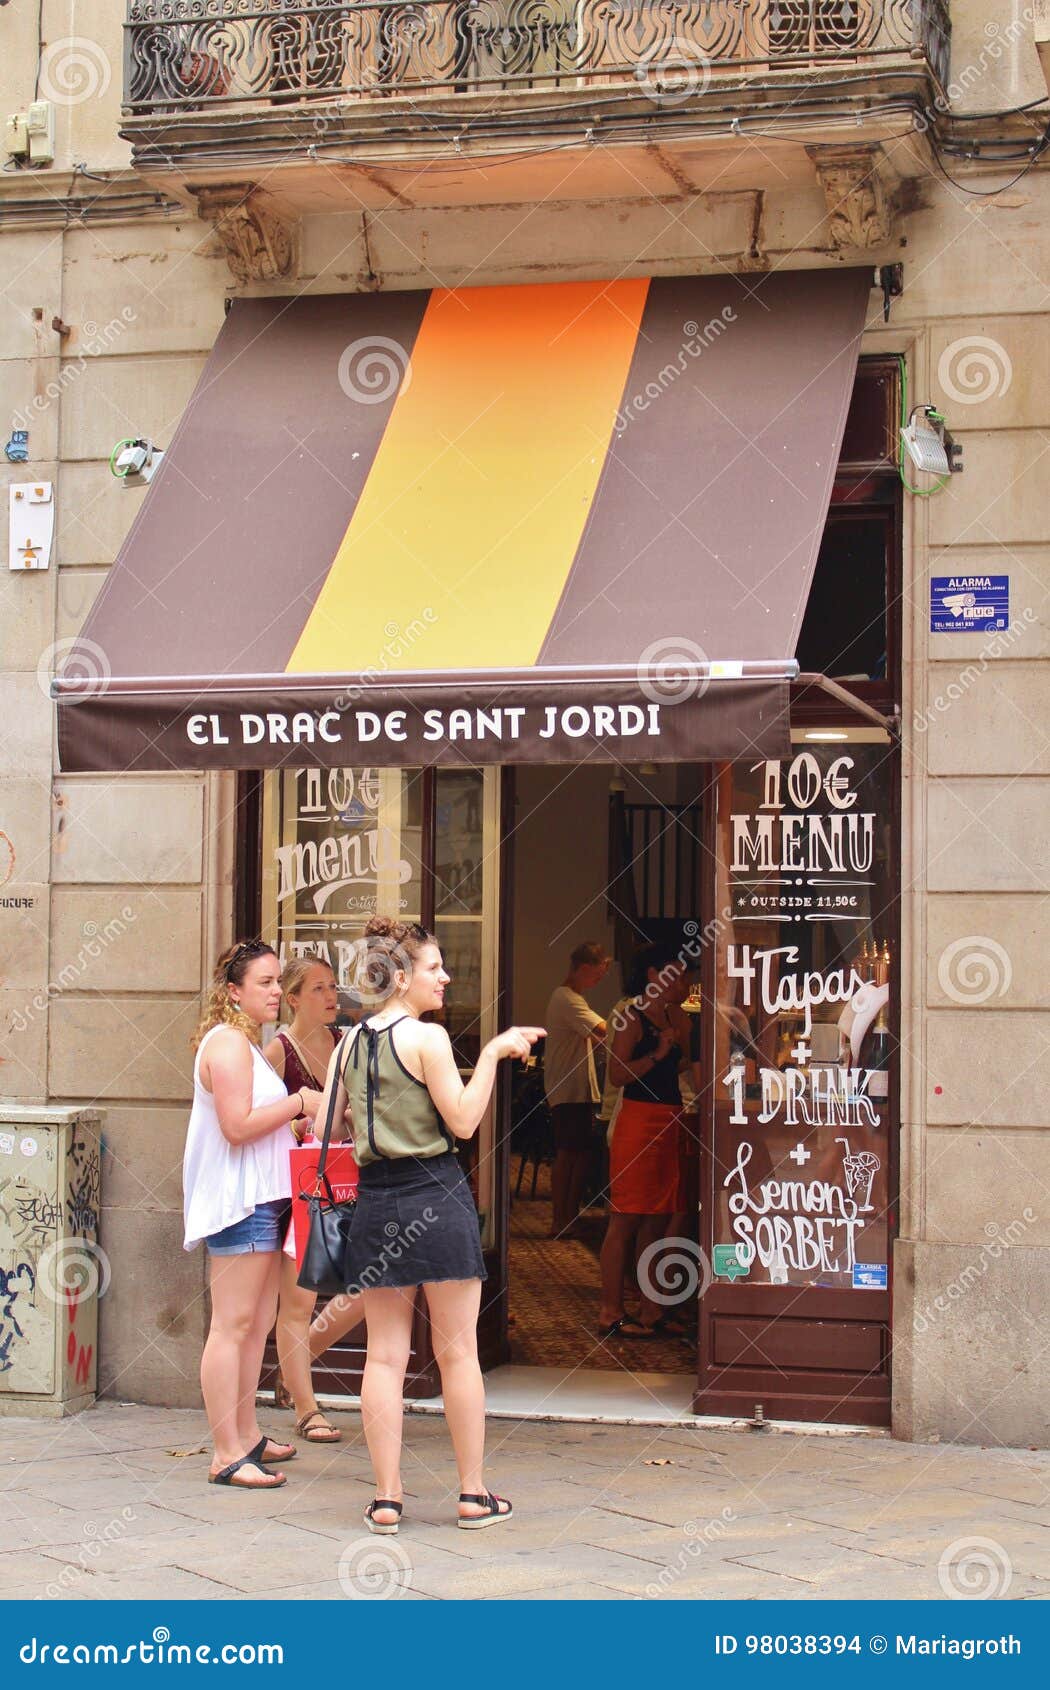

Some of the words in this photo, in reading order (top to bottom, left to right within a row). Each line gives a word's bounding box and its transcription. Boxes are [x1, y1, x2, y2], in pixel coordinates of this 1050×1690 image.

[948, 578, 991, 588] ALARMA
[965, 607, 994, 616] rue
[186, 714, 230, 745] EL
[239, 711, 342, 744] DRAC
[355, 710, 408, 742] DE
[423, 707, 526, 741] SANT
[538, 704, 661, 738] JORDI
[295, 768, 383, 813] 10€
[750, 752, 858, 810] 10€
[274, 827, 413, 905] menu
[729, 813, 877, 873] MENU
[750, 896, 812, 907] OUTSIDE
[727, 944, 756, 1006] 4
[752, 945, 877, 1039] Tapas
[722, 1066, 748, 1125] 1
[757, 1067, 881, 1127] DRINK
[723, 1142, 858, 1220] Lemon
[733, 1215, 865, 1273] SORBET
